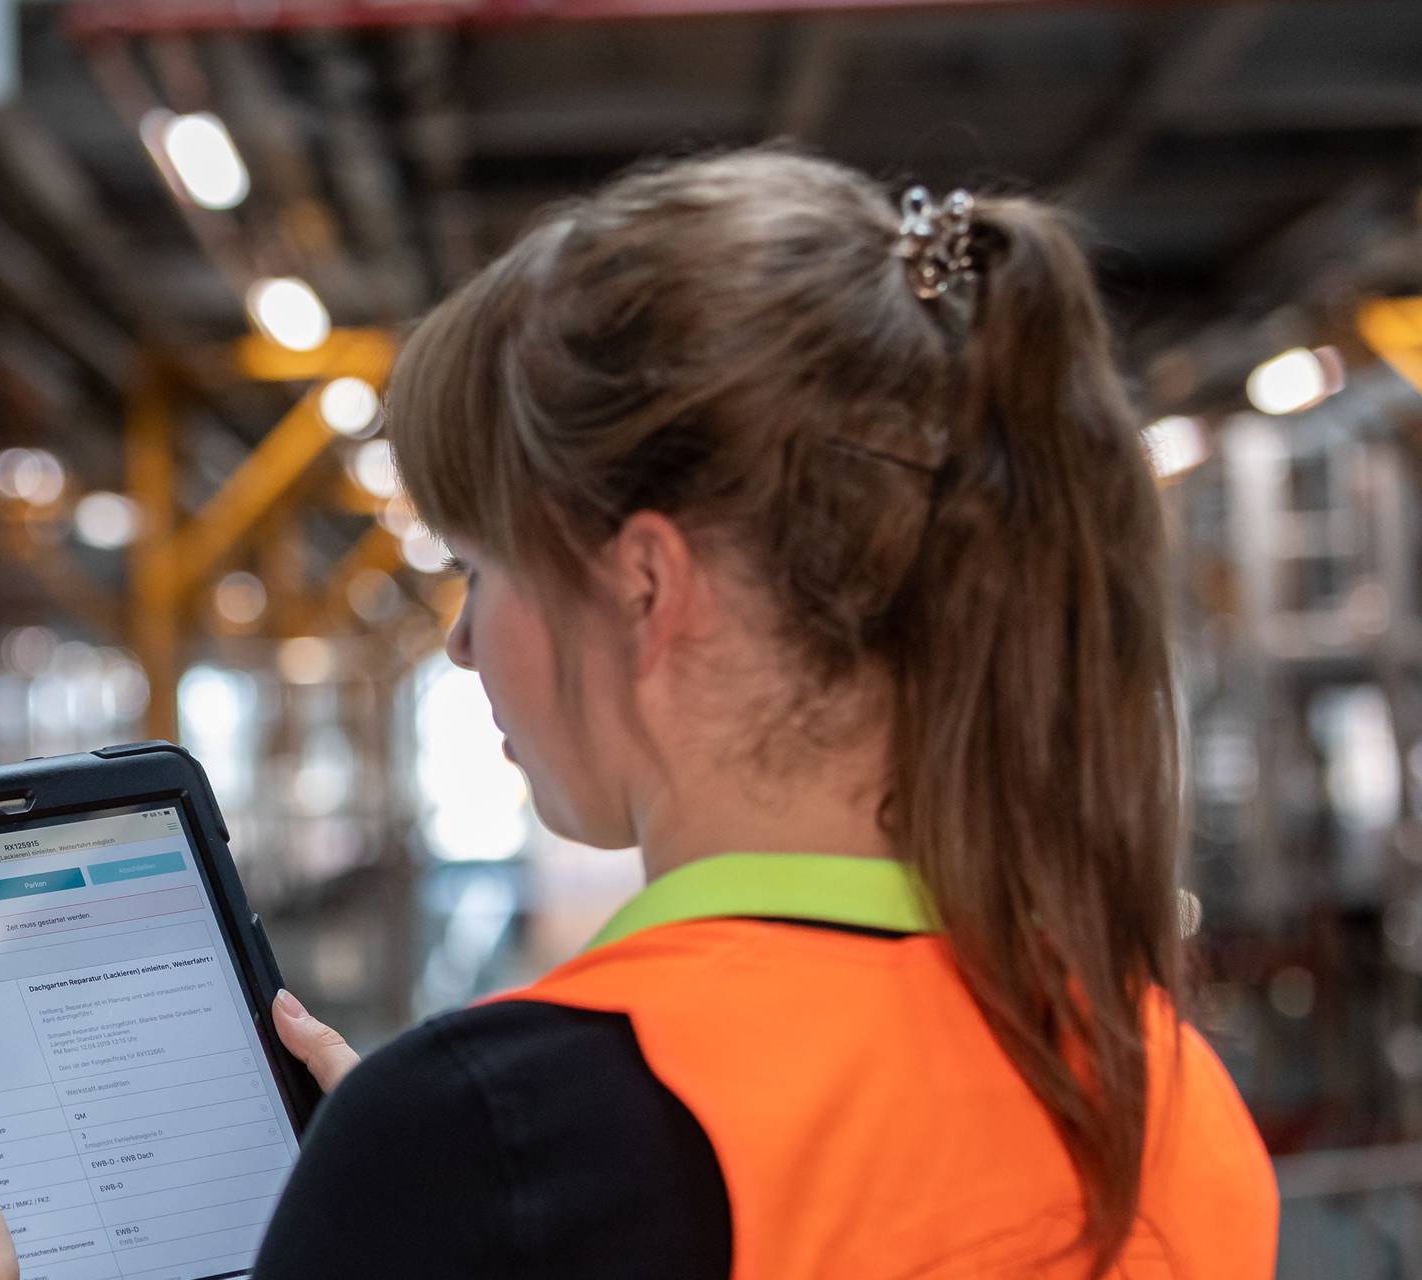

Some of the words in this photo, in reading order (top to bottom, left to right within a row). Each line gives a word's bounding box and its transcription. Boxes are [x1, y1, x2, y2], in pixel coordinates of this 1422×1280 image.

[4, 840, 39, 851] RX125915
[58, 841, 91, 851] Weiterfahrt
[24, 880, 47, 888] Parken
[5, 923, 18, 931] Zeit
[19, 921, 36, 929] muss
[37, 916, 66, 927] gestartet
[28, 980, 68, 992] Dachgarten
[68, 975, 101, 985] Reparatur
[101, 967, 140, 980] (Lackieren)
[140, 963, 172, 973] einleiten,
[171, 955, 209, 968] Weiterfahrt
[64, 1002, 92, 1010] Reparatur
[156, 983, 196, 995] voraussichtlich
[71, 1026, 99, 1034] Reparatur
[138, 1015, 157, 1023] Blanke
[157, 1012, 173, 1020] Stelle
[76, 1033, 102, 1042] Standzeit
[90, 1055, 127, 1065] Folgeauftrag
[64, 1084, 96, 1096] Werkstatt
[97, 1079, 130, 1091] auswählen
[74, 1112, 87, 1120] QM
[84, 1138, 113, 1148] Entspricht
[113, 1130, 157, 1143] Fehlerkategorie
[90, 1158, 115, 1168] EWB-D
[120, 1154, 136, 1163] EWB
[136, 1150, 154, 1160] Dach
[99, 1181, 124, 1192] EWB-D
[115, 1225, 140, 1236] EWB-D
[58, 1240, 94, 1252] Komponente
